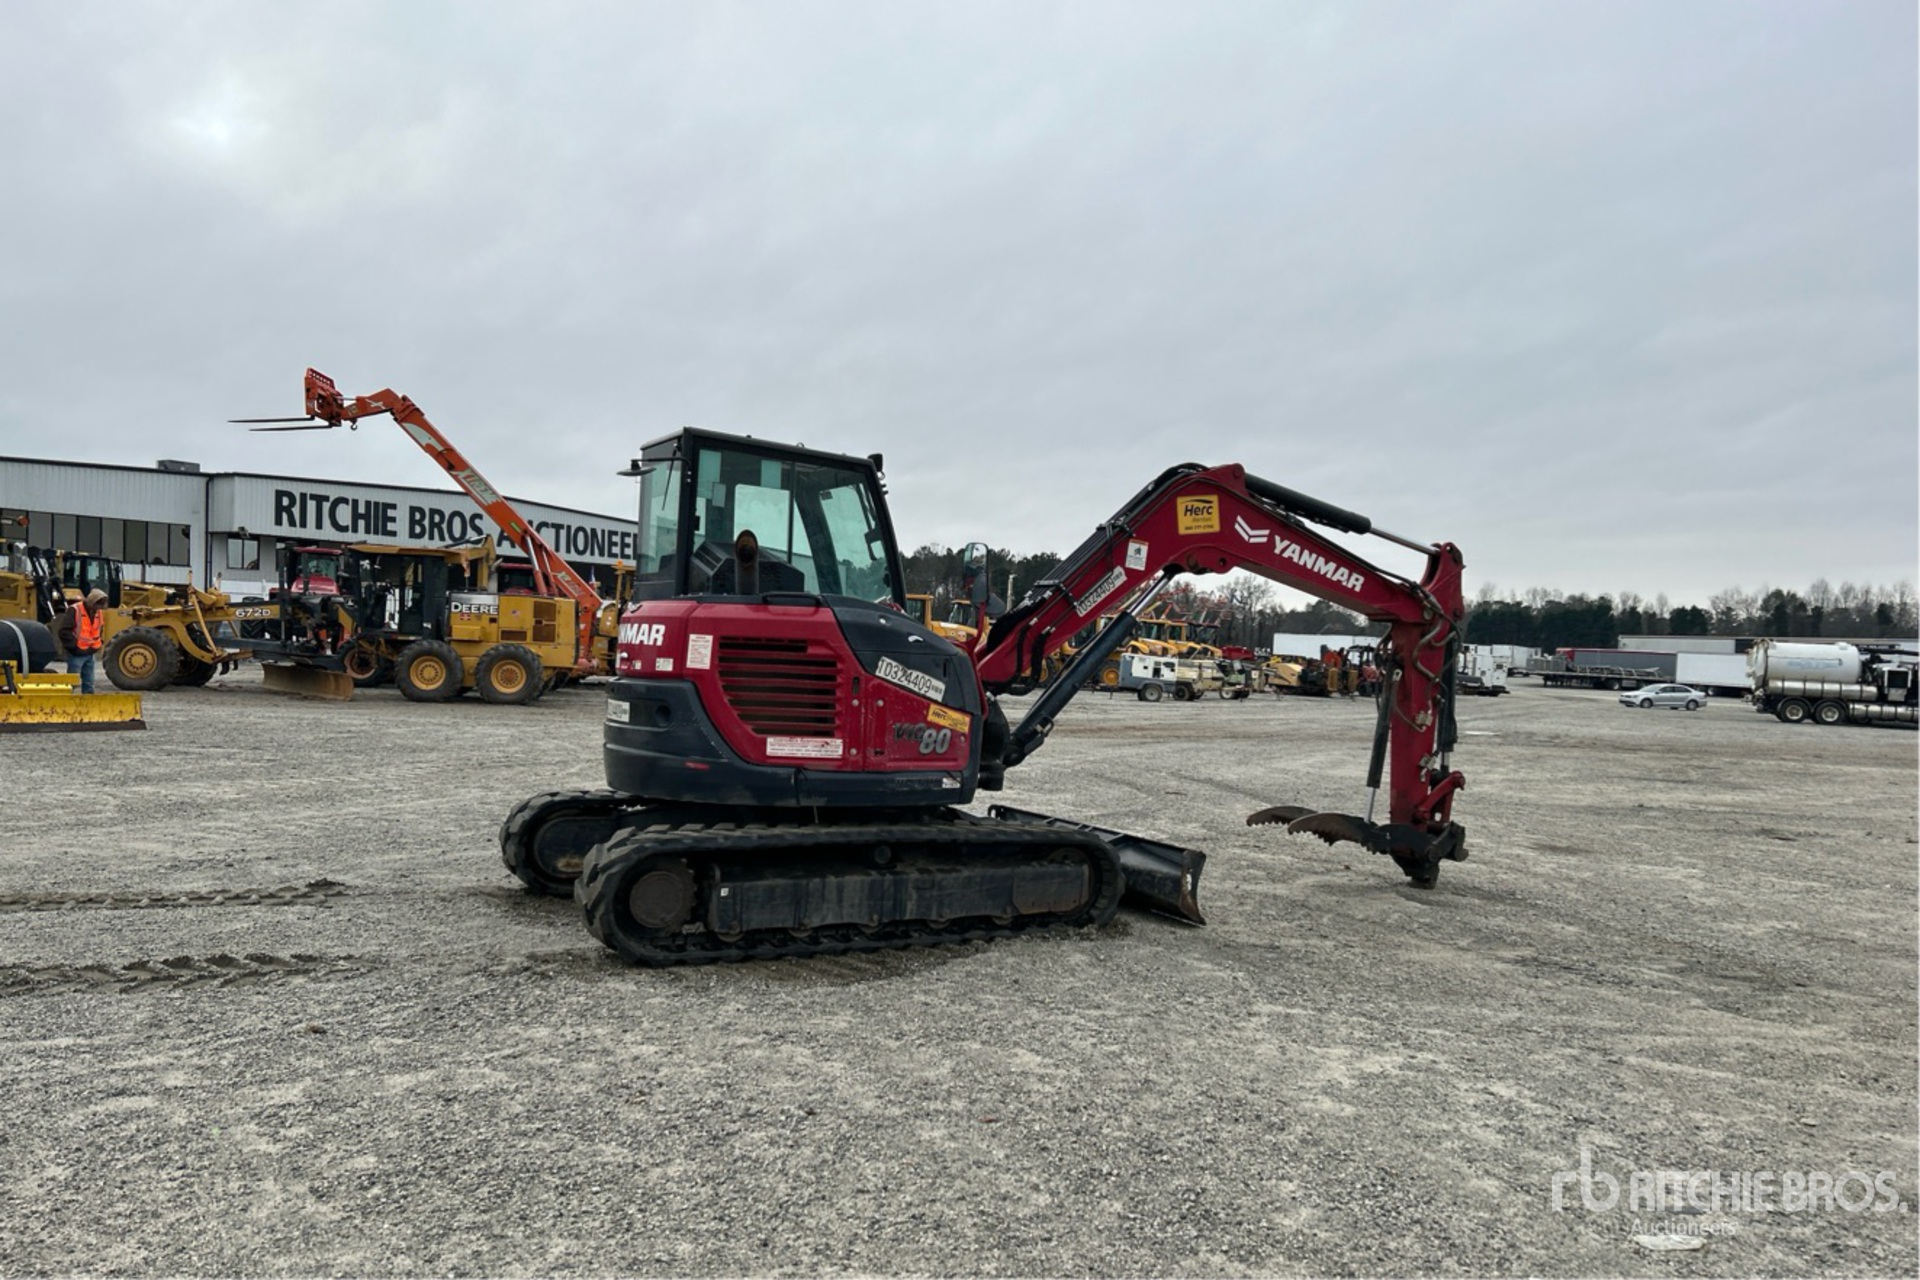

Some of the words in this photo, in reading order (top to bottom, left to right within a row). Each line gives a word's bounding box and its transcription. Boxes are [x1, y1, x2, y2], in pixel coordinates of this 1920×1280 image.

[274, 489, 397, 537] RITCHIE
[1184, 504, 1214, 517] Herc
[1273, 534, 1365, 593] YANMAR
[235, 607, 272, 618] 672D
[450, 601, 499, 615] DEERE
